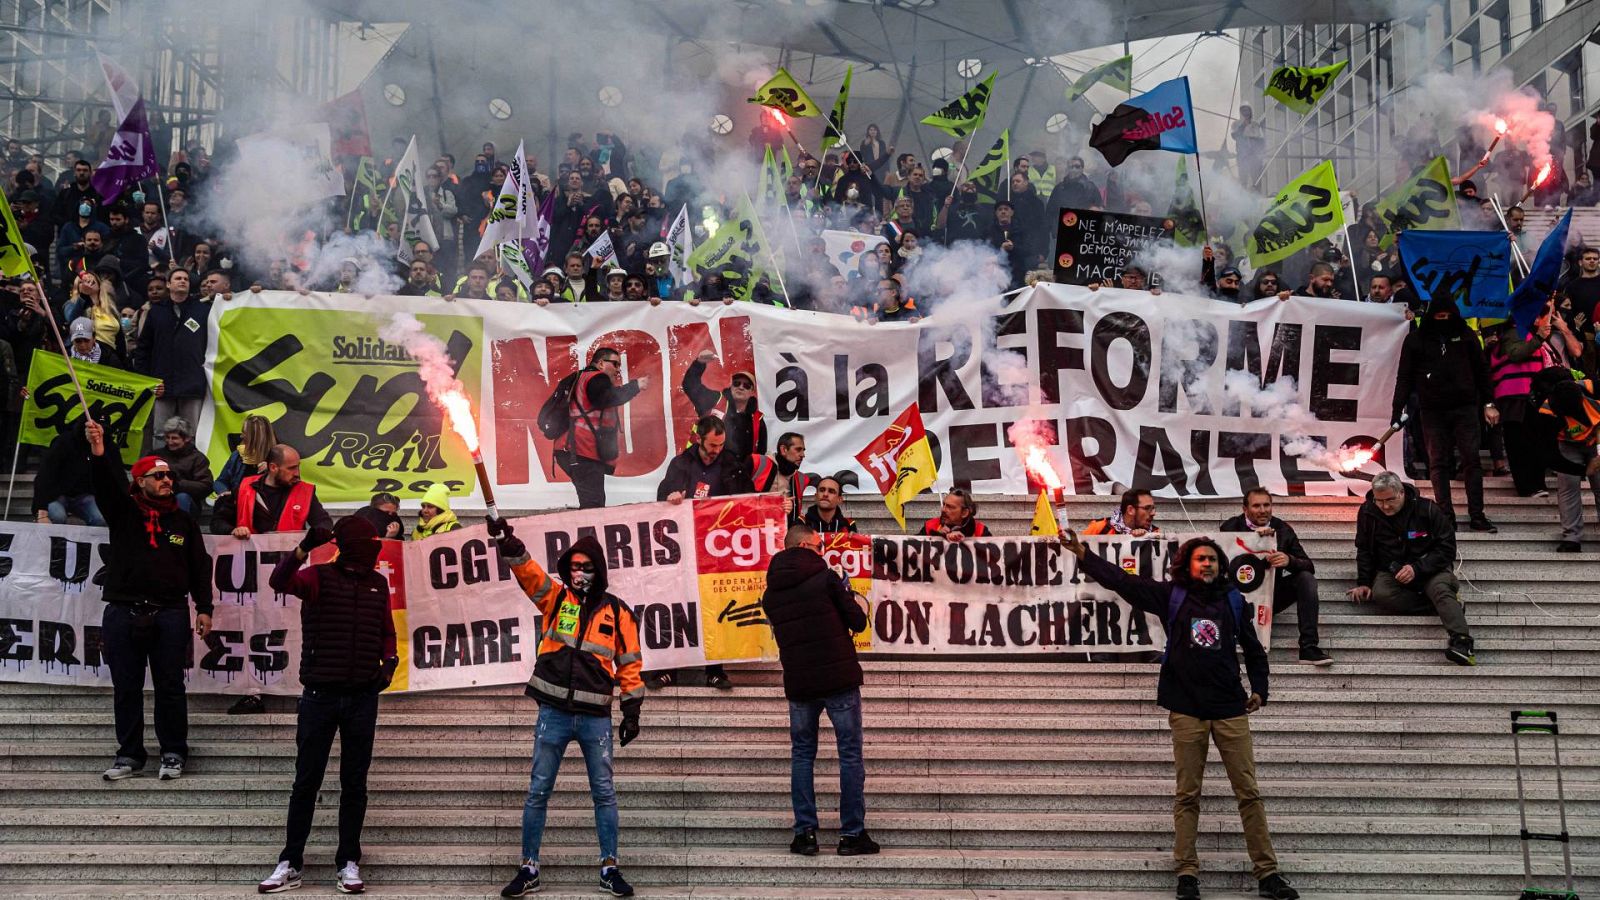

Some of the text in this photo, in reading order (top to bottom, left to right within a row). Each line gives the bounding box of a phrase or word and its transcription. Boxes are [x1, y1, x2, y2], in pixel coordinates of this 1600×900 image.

[1078, 219, 1165, 240] NE M'APPELEZ
[1083, 232, 1116, 246] PLUS
[1076, 264, 1161, 287] MACRIE
[85, 379, 136, 400] Solidaires
[491, 316, 759, 486] NON
[774, 352, 810, 423] à
[834, 354, 889, 421] la
[317, 429, 448, 473] Rail
[704, 518, 786, 566] cgt
[822, 545, 873, 577] cgt
[713, 576, 763, 586] FEDERATI
[872, 538, 1063, 586] REFORME
[875, 599, 933, 646] ON
[947, 599, 1153, 647] LACHERA
[412, 617, 522, 670] GARE
